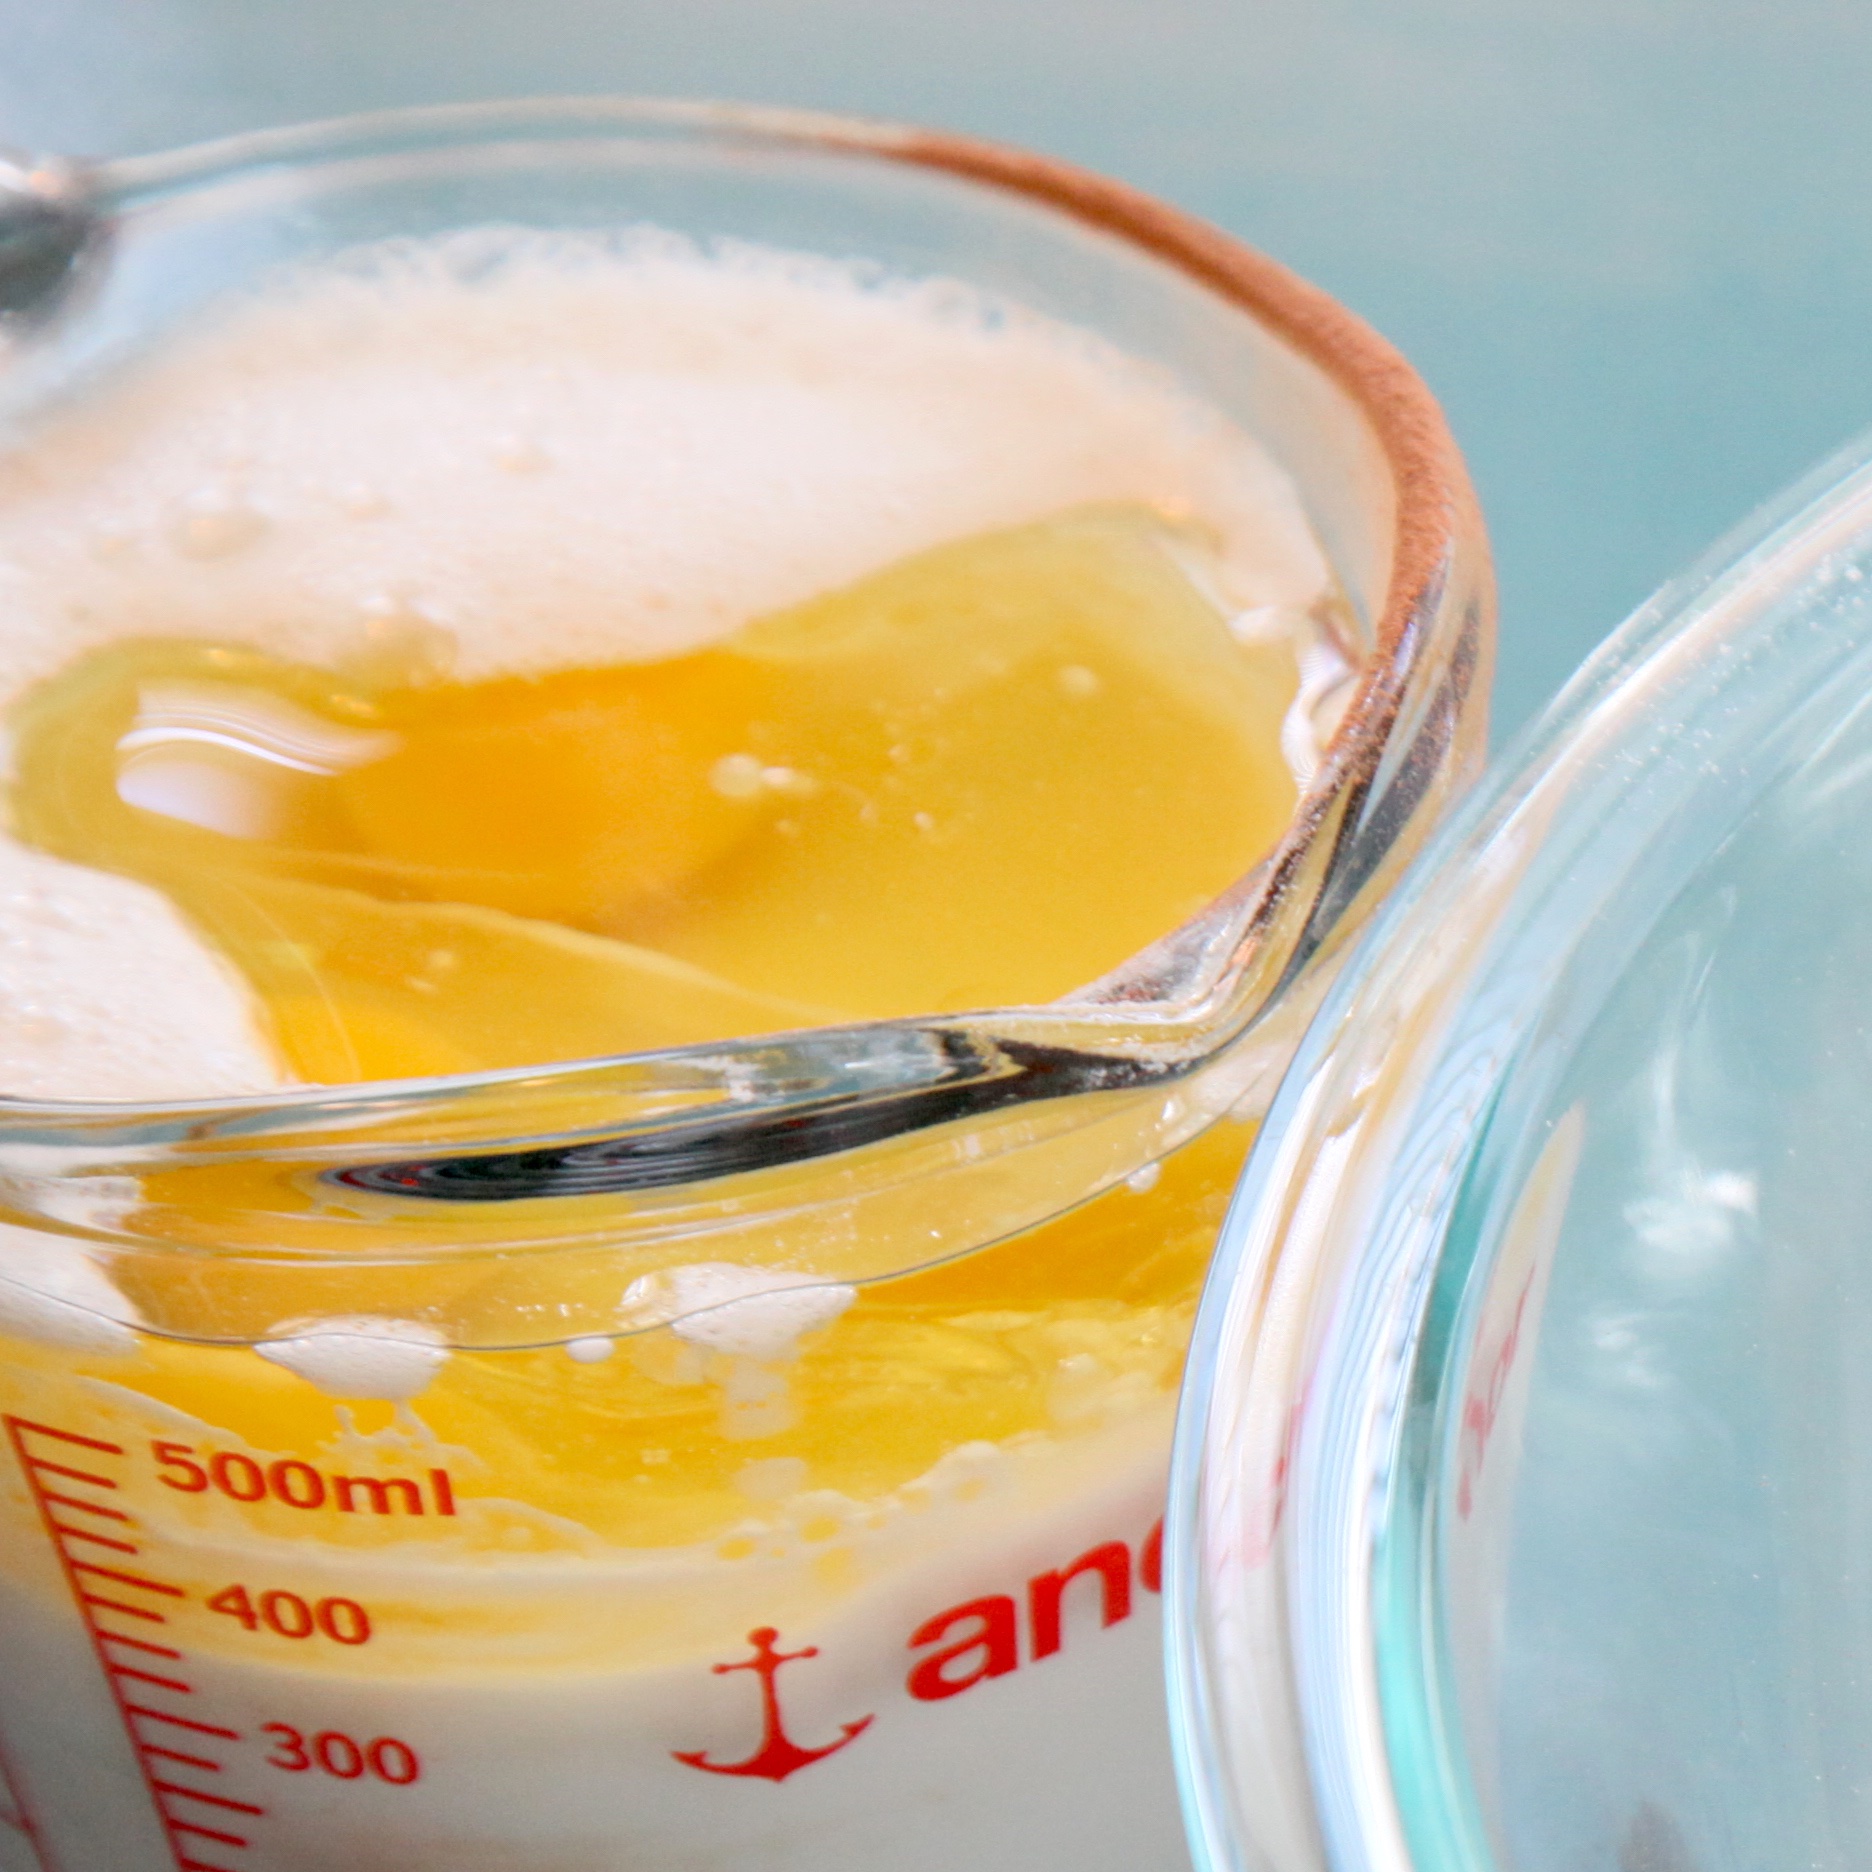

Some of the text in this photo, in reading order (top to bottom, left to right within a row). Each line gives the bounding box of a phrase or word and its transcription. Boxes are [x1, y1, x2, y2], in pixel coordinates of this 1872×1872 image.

[150, 1440, 457, 1517] 500ml
[206, 1584, 373, 1647] 400
[259, 1721, 422, 1786] 300
